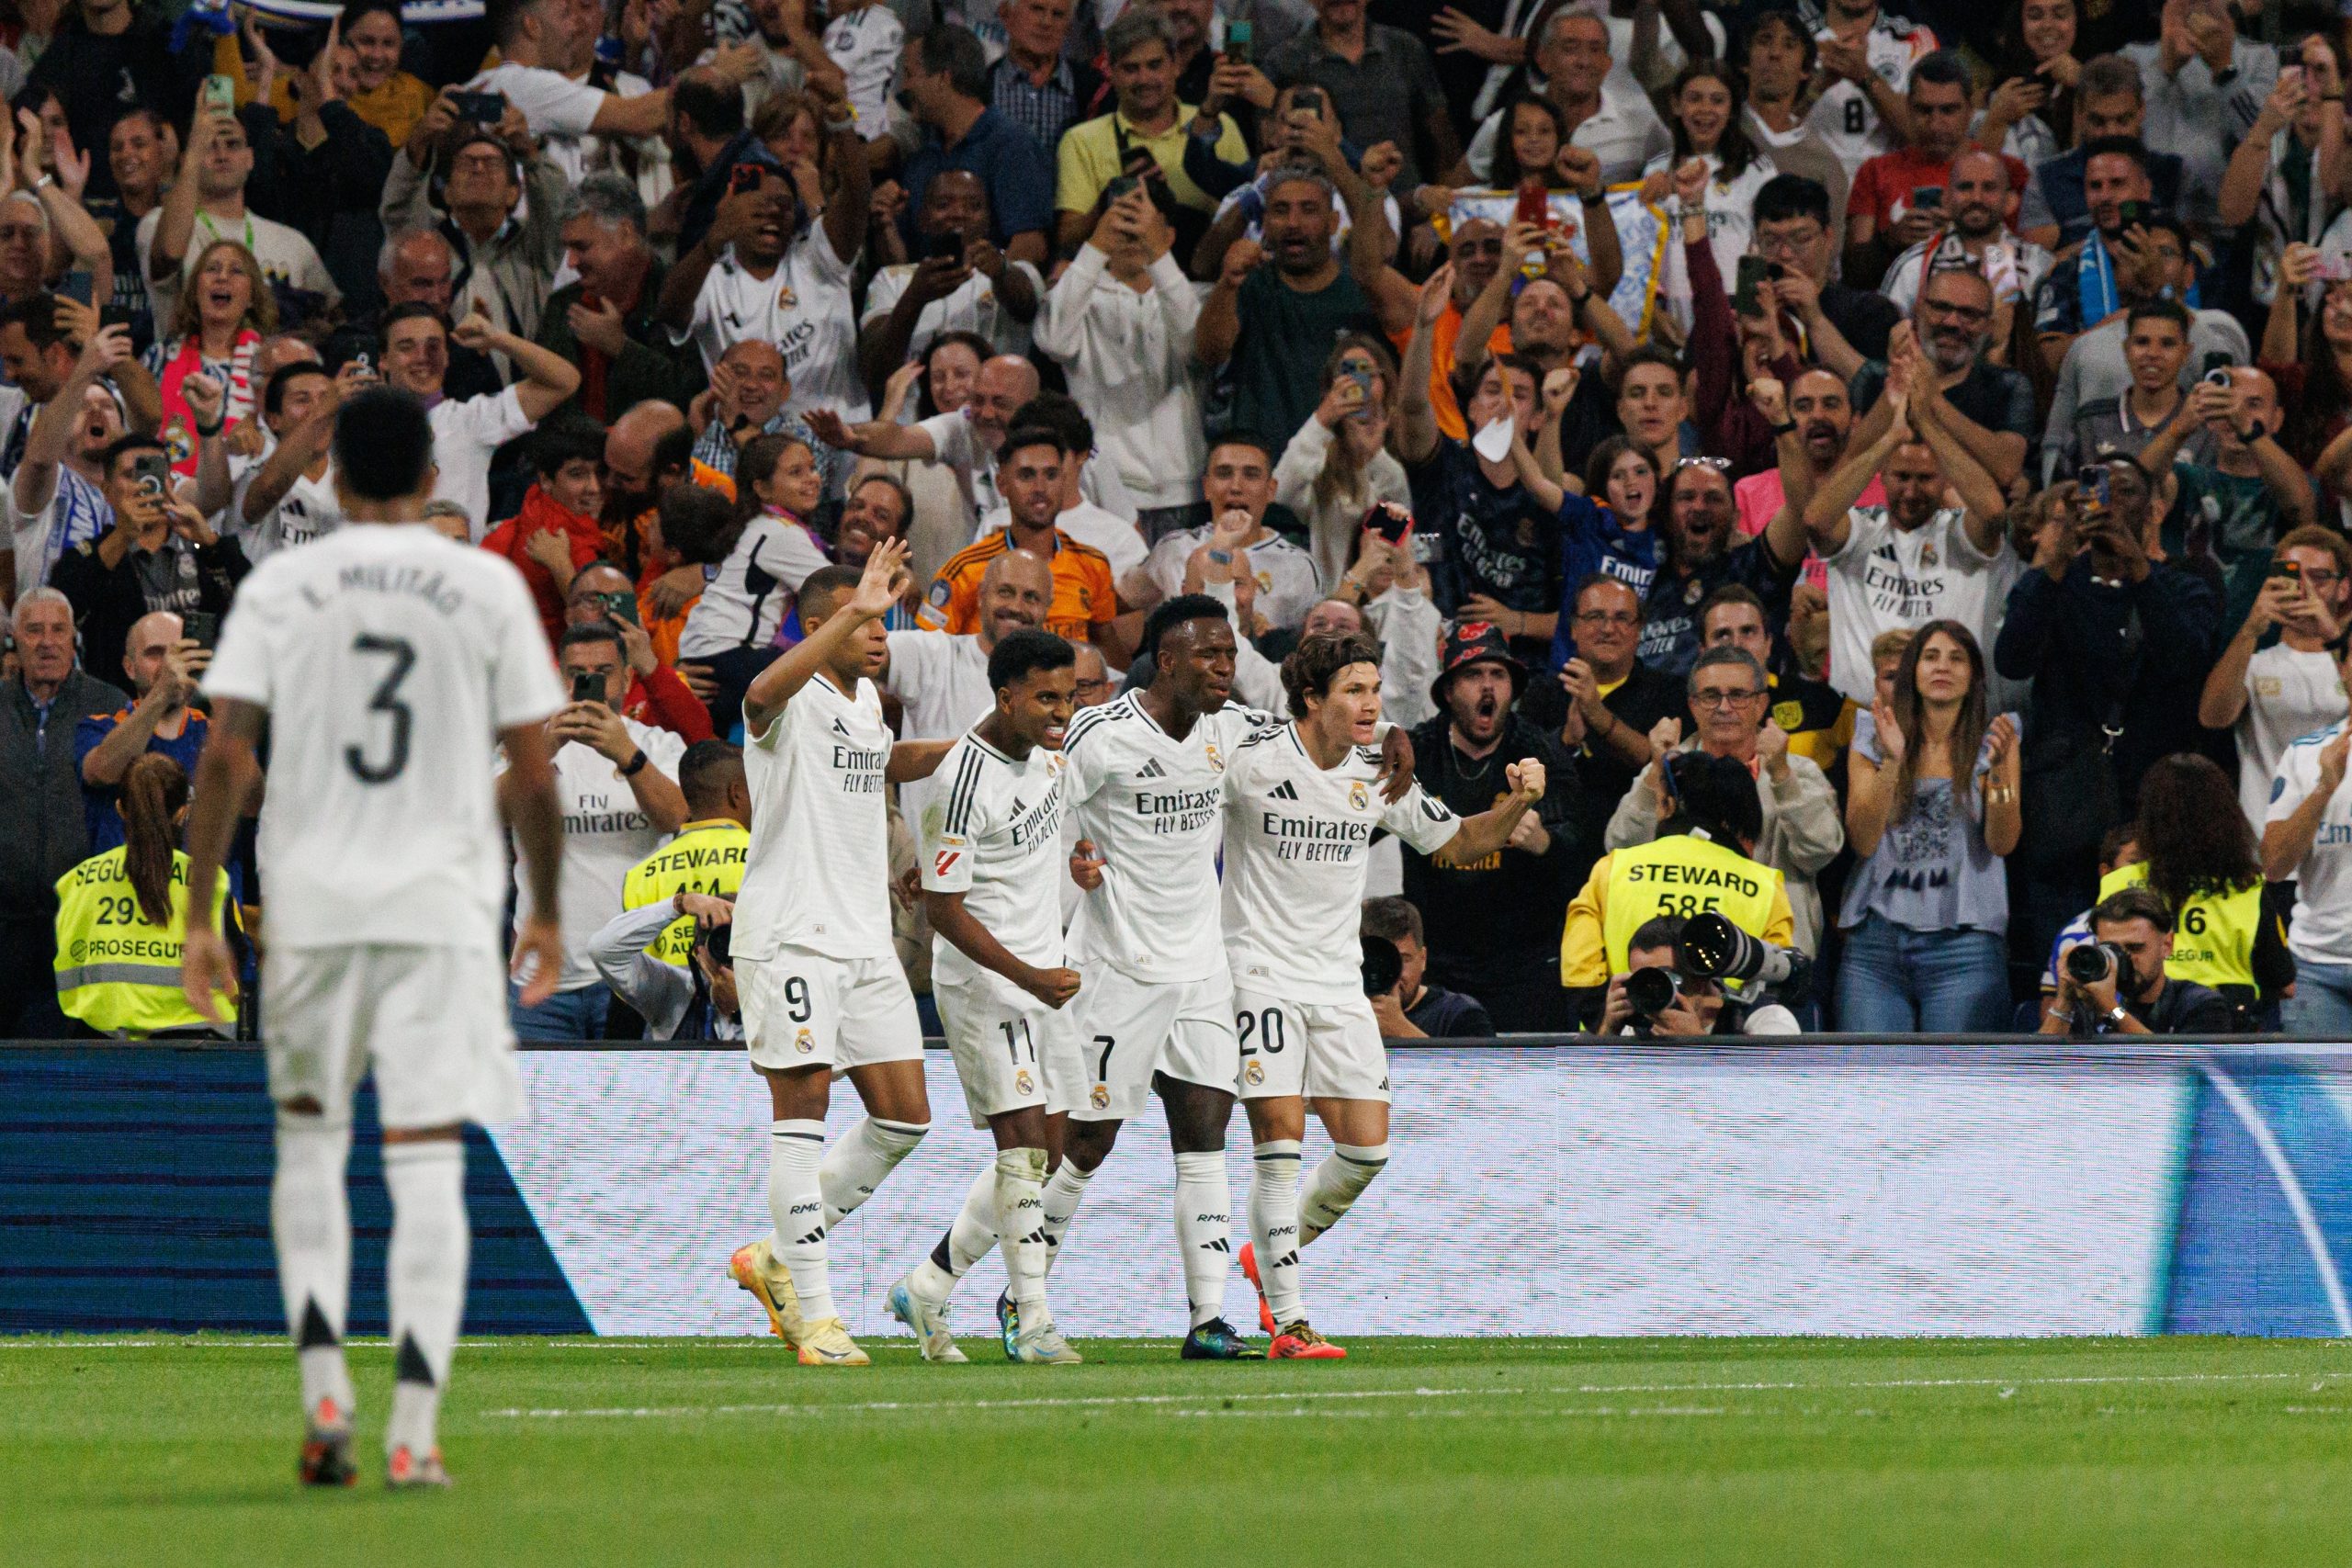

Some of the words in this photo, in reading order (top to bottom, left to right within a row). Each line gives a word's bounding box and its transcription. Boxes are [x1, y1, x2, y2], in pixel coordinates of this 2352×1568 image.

[1846, 97, 1864, 133] 8
[345, 632, 417, 784] 3
[832, 745, 885, 770] Emira
[843, 773, 861, 792] FLY
[1135, 789, 1220, 815] Emirate
[563, 809, 649, 834] mirates
[1154, 815, 1175, 835] FLY
[1263, 812, 1367, 840] Emirates
[1277, 840, 1302, 860] FLY
[1306, 841, 1352, 862] BETTER
[1629, 863, 1758, 897] STEWARD
[96, 897, 153, 926] 29
[1657, 893, 1720, 919] 585
[784, 976, 811, 1023] 9
[999, 1017, 1035, 1066] 11
[1237, 1007, 1284, 1056] 20
[1093, 1034, 1115, 1082] 7
